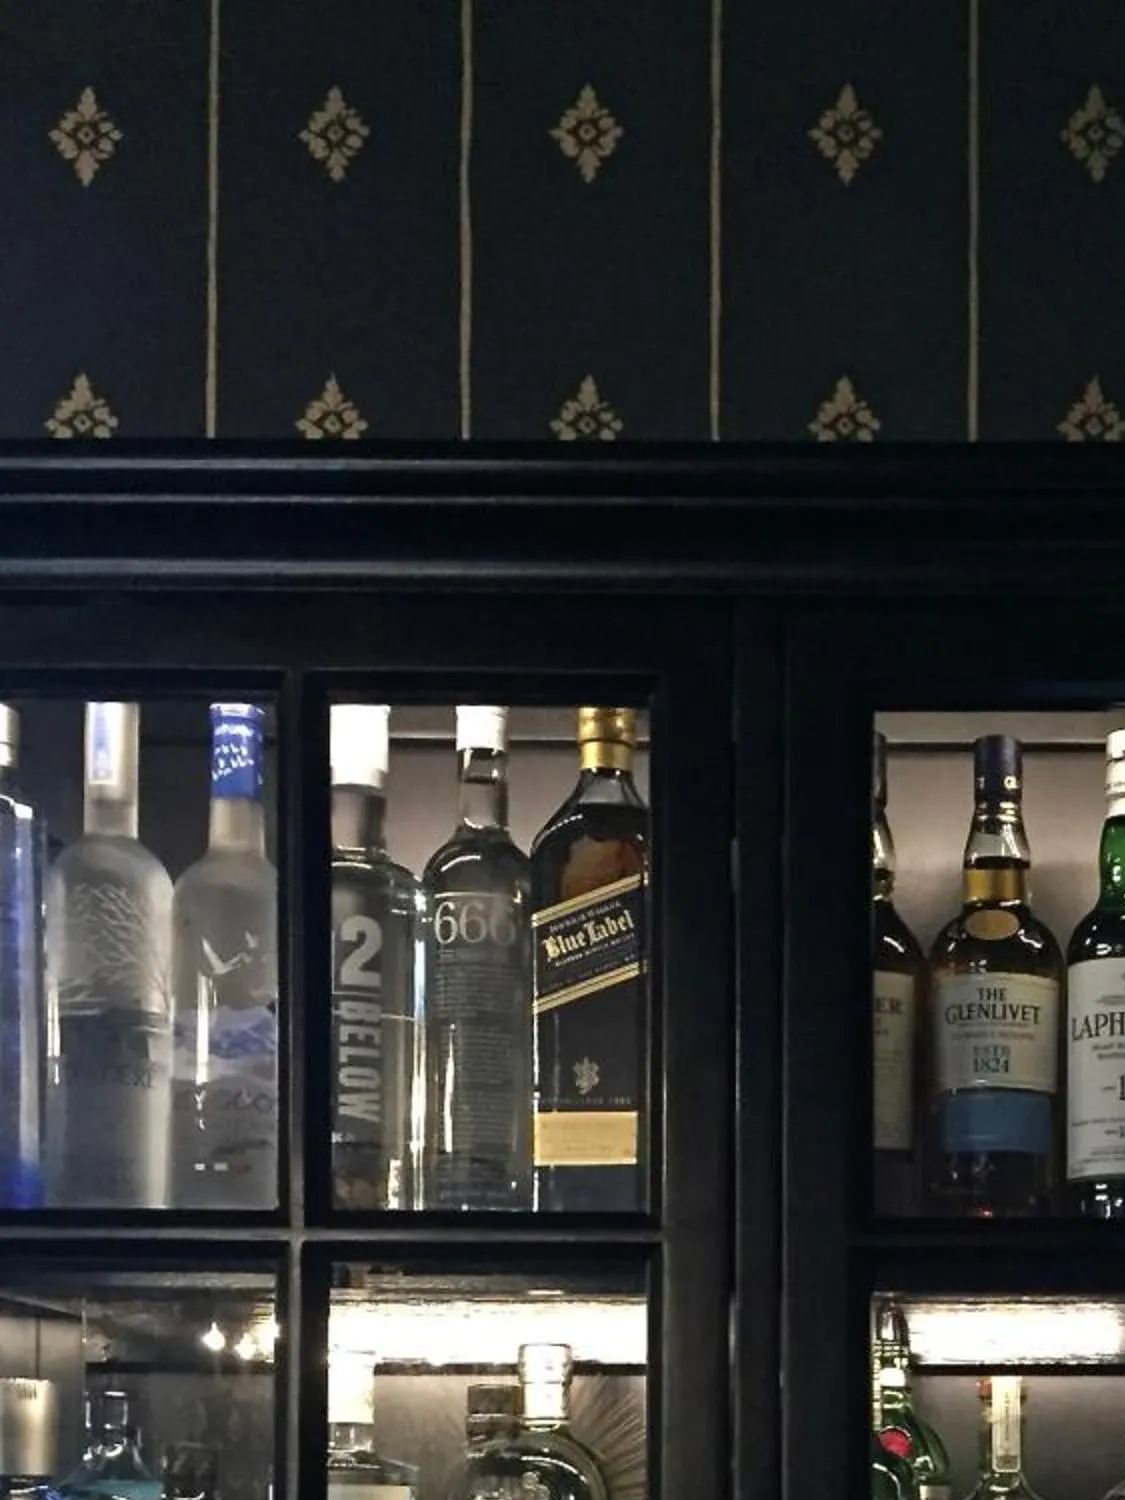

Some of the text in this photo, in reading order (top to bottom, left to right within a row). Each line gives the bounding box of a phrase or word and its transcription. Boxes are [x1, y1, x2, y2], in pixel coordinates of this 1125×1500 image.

[433, 900, 517, 945] 666
[541, 930, 588, 963] Blue
[583, 908, 635, 947] Label
[976, 987, 1009, 1002] THE
[944, 1002, 1041, 1026] GLENLIVET
[337, 1001, 383, 1124] BELOW
[973, 1057, 1009, 1073] 1824
